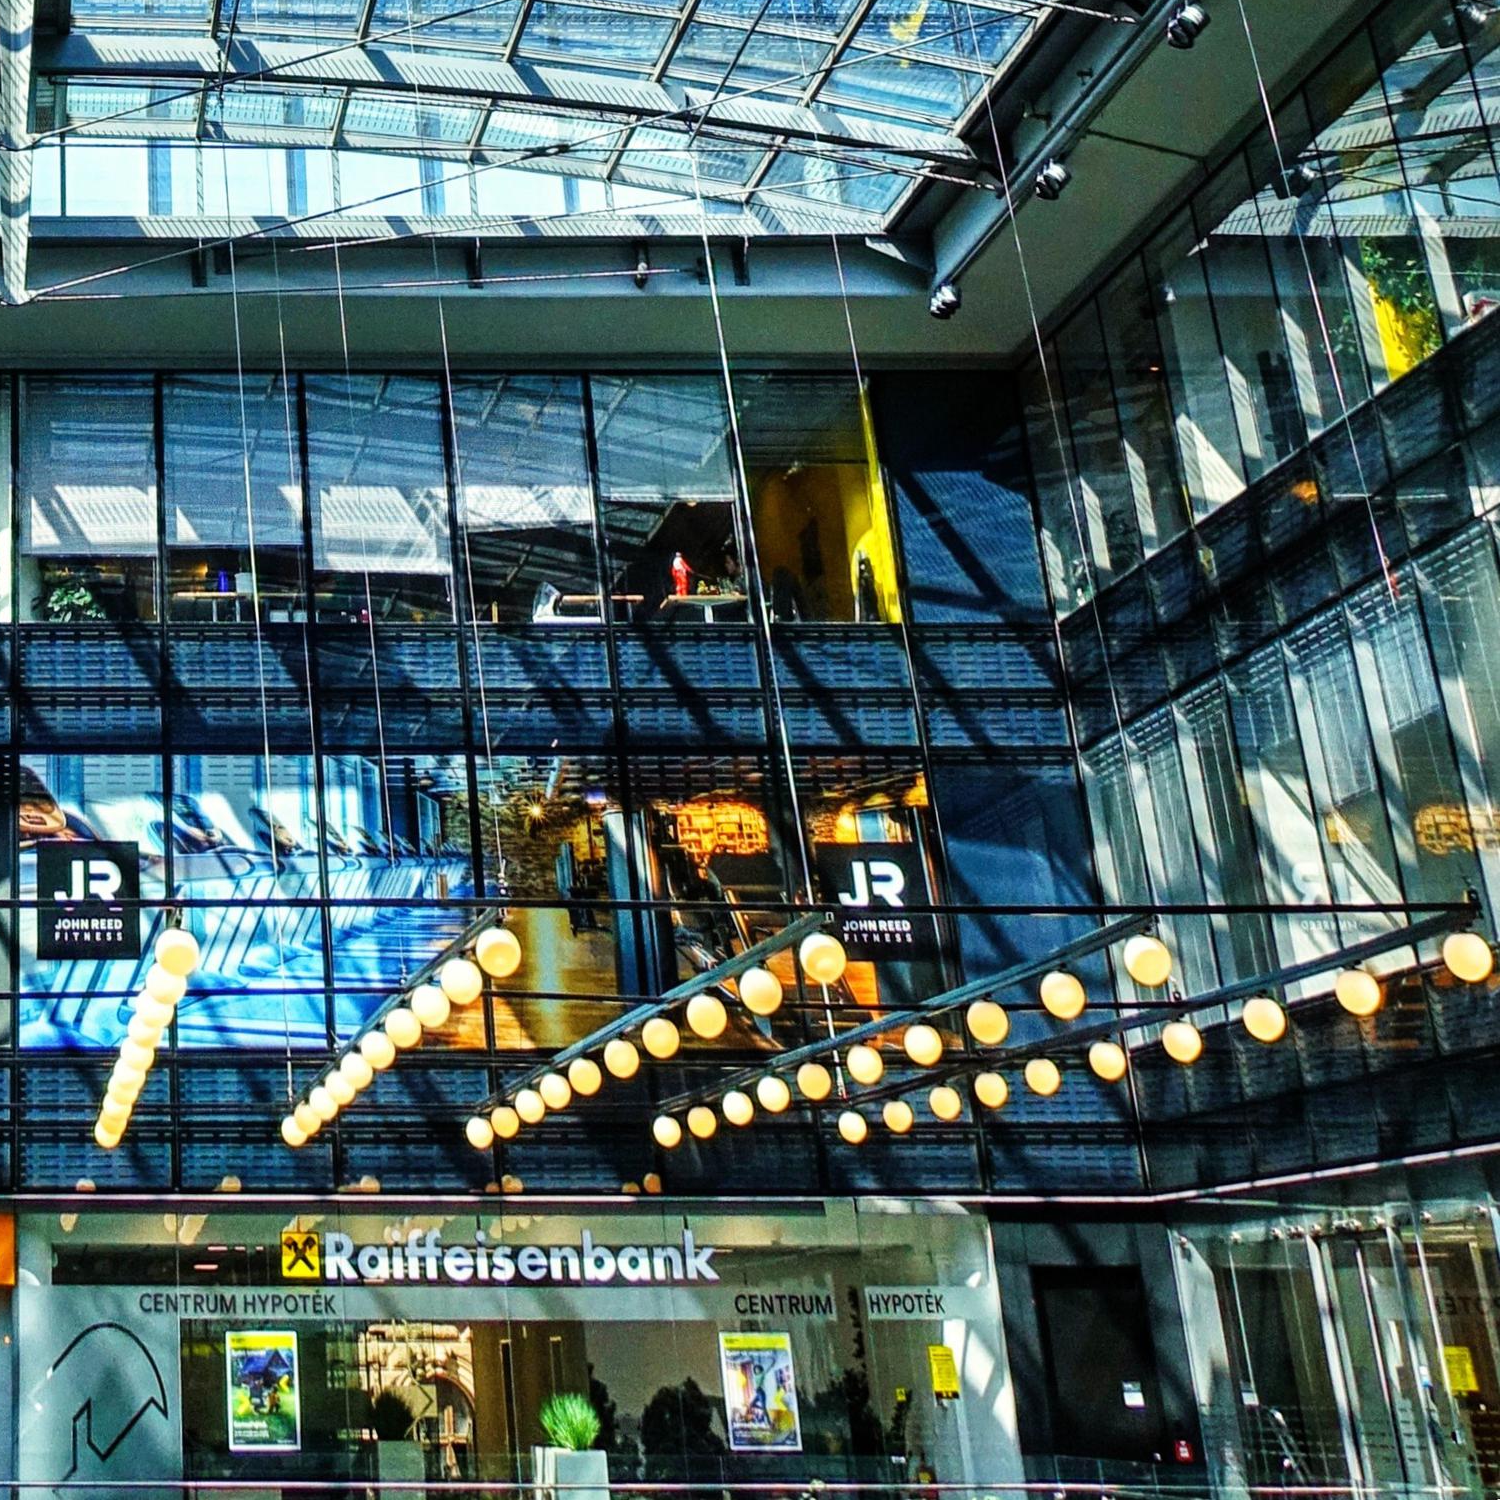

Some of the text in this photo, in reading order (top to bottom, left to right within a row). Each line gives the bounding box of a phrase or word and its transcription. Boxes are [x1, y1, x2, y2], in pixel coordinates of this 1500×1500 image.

[53, 859, 123, 911] JR
[837, 861, 905, 907] JR
[54, 918, 123, 930] JOHN REED
[54, 931, 123, 942] FITNESS
[842, 919, 911, 932] JOHN REED
[842, 933, 913, 943] FITNESS
[323, 1229, 721, 1282] Raiffeisenbank
[139, 1289, 336, 1314] CENTRUM HYPOTÉK
[734, 1288, 946, 1315] CENTRUM HYPOTÉK
